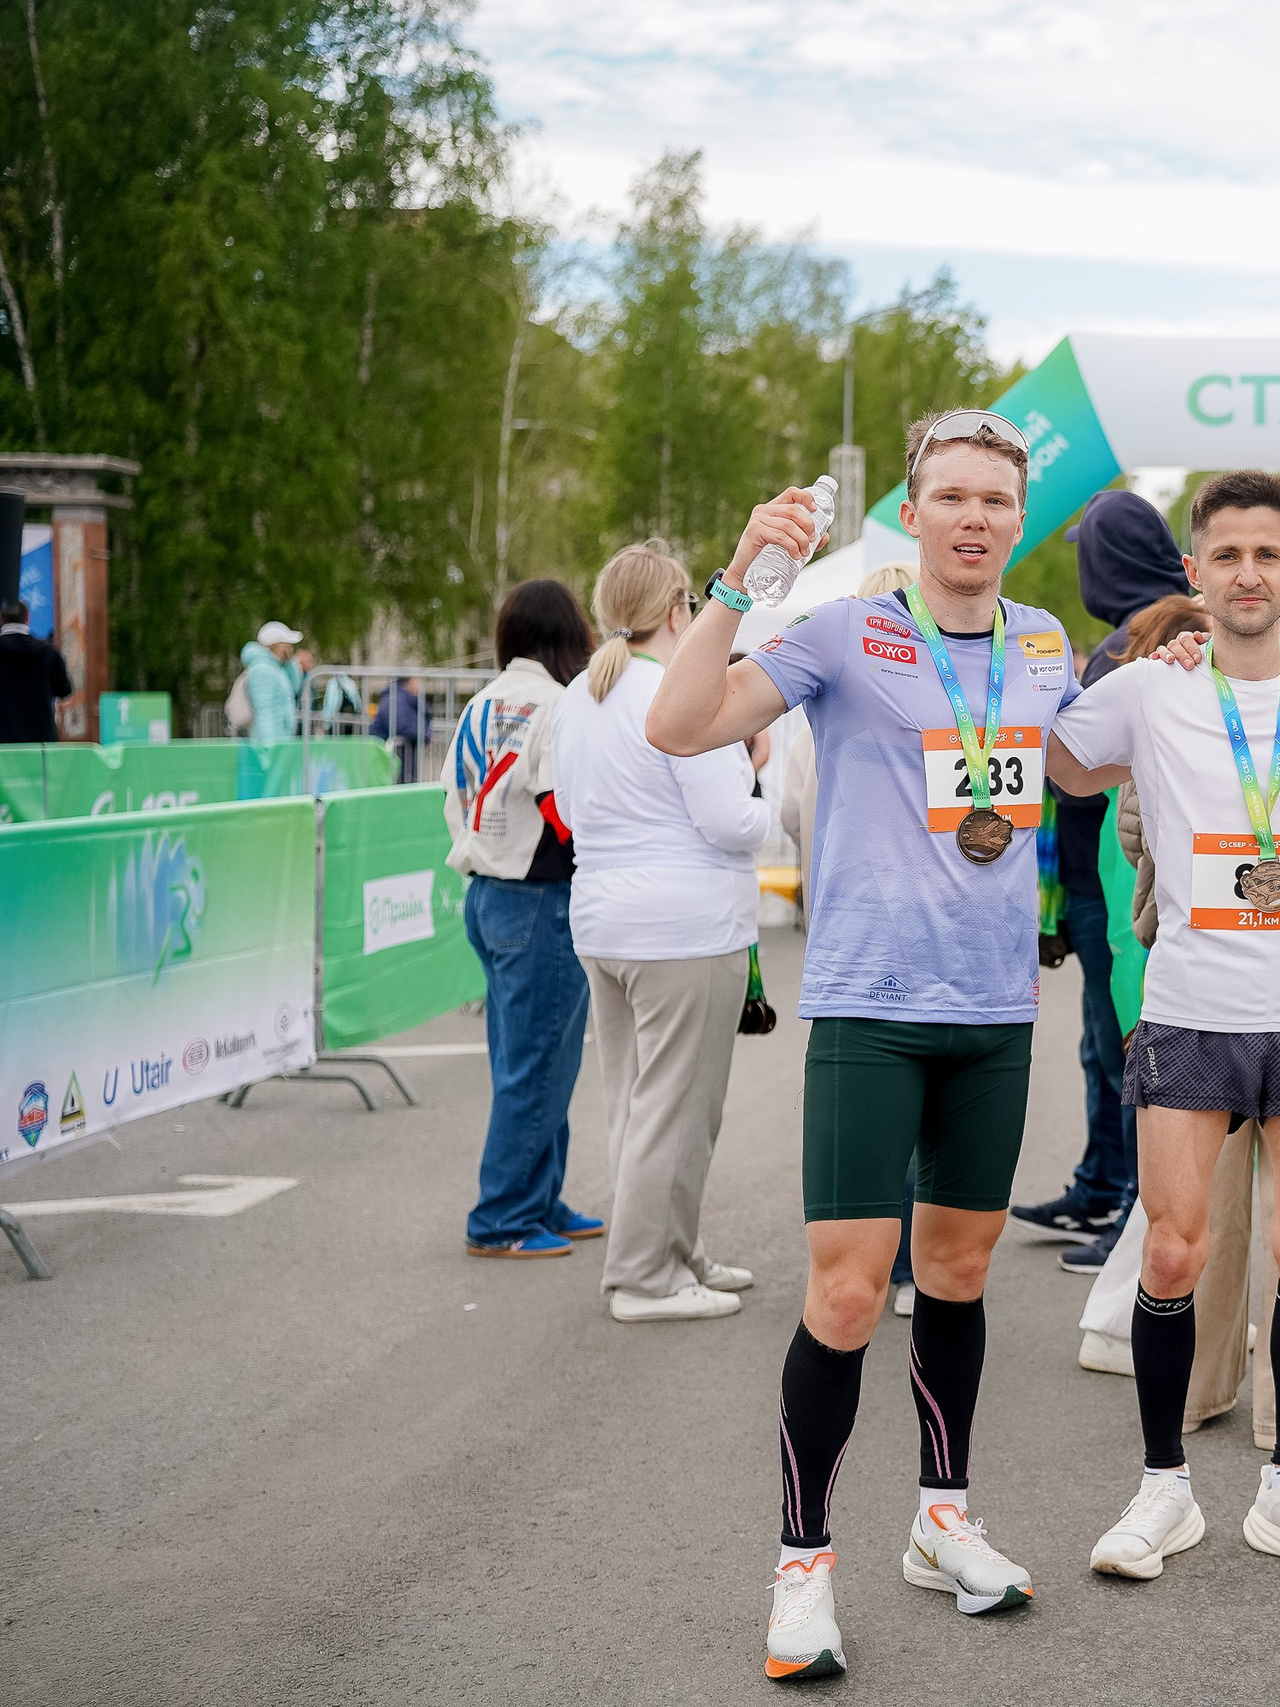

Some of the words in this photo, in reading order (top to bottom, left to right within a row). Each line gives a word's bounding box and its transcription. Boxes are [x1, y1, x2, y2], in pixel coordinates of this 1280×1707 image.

[954, 756, 1024, 797] 233
[1240, 755, 1250, 774] СБЕР
[1238, 912, 1262, 927] 21,1
[131, 1051, 172, 1097] Utair
[1147, 1046, 1158, 1077] CRAFT
